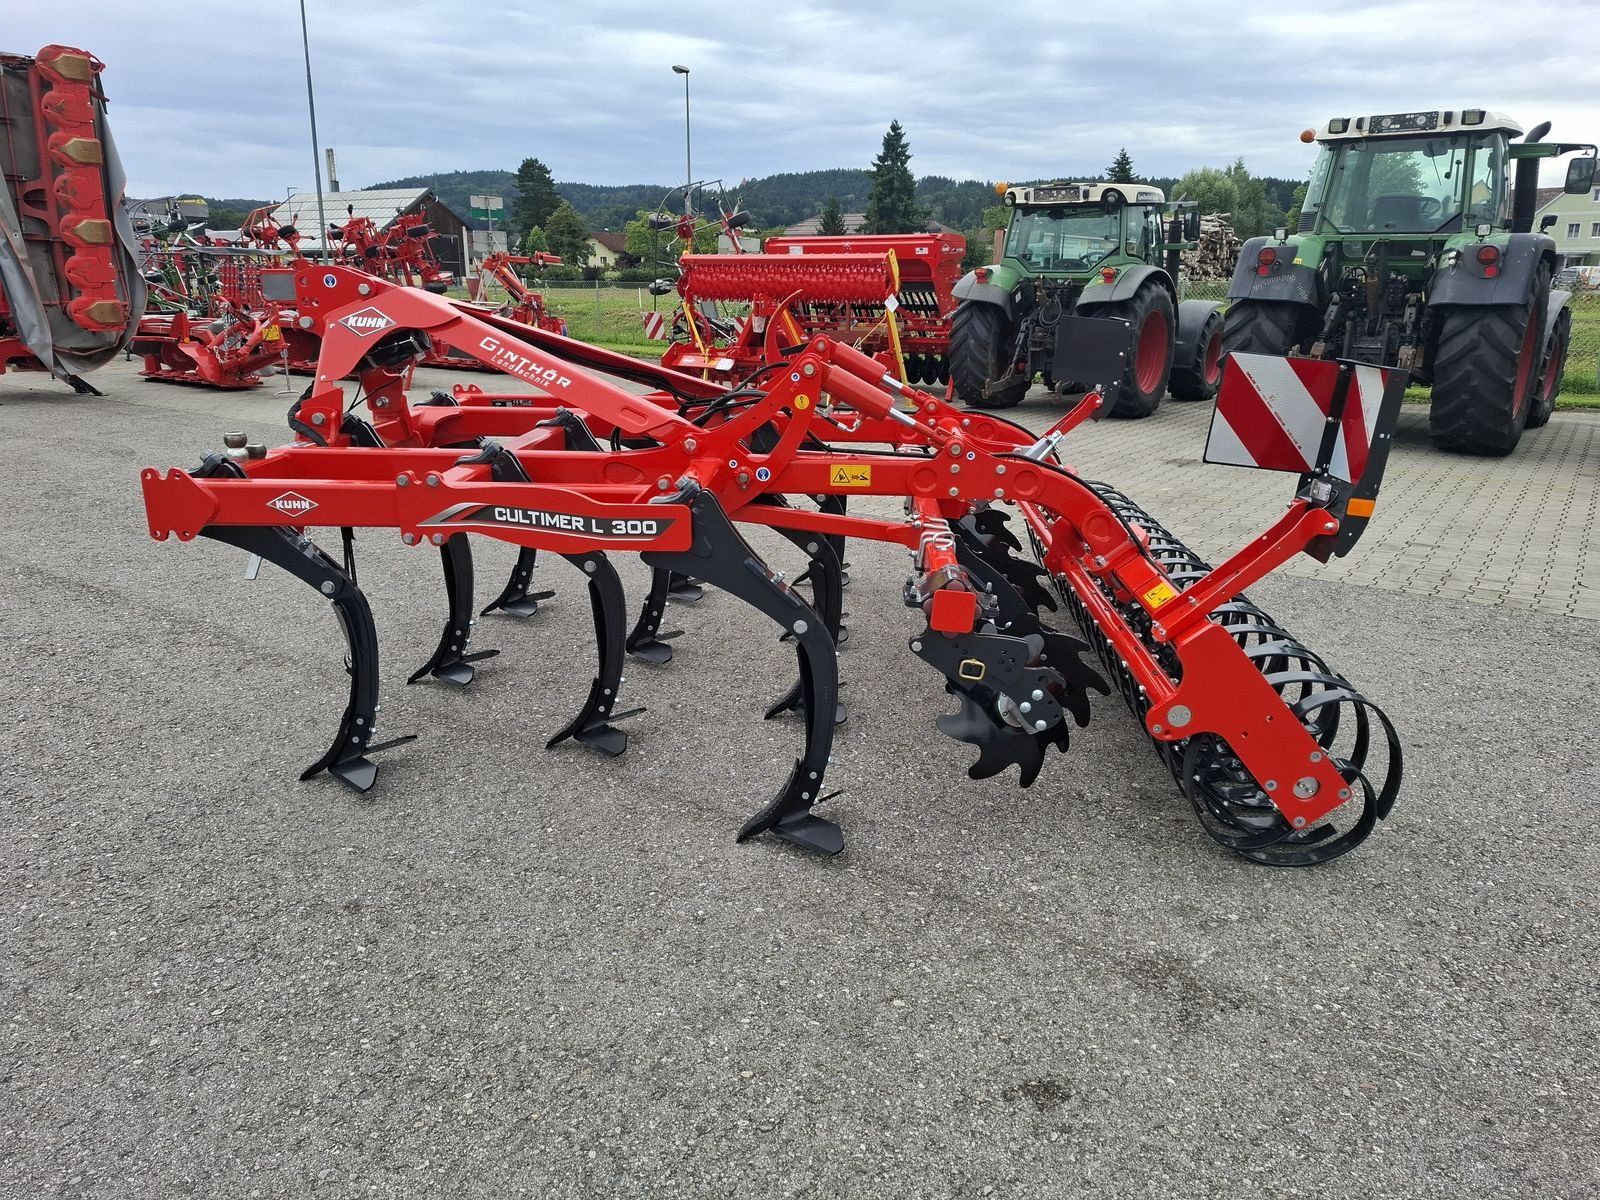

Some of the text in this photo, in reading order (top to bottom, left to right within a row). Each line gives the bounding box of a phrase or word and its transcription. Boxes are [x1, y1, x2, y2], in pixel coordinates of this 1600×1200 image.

[347, 316, 388, 329] KUHN
[479, 335, 573, 389] GINTHÖR
[275, 500, 310, 509] KUHN
[494, 507, 657, 535] CULTIMER L 300
